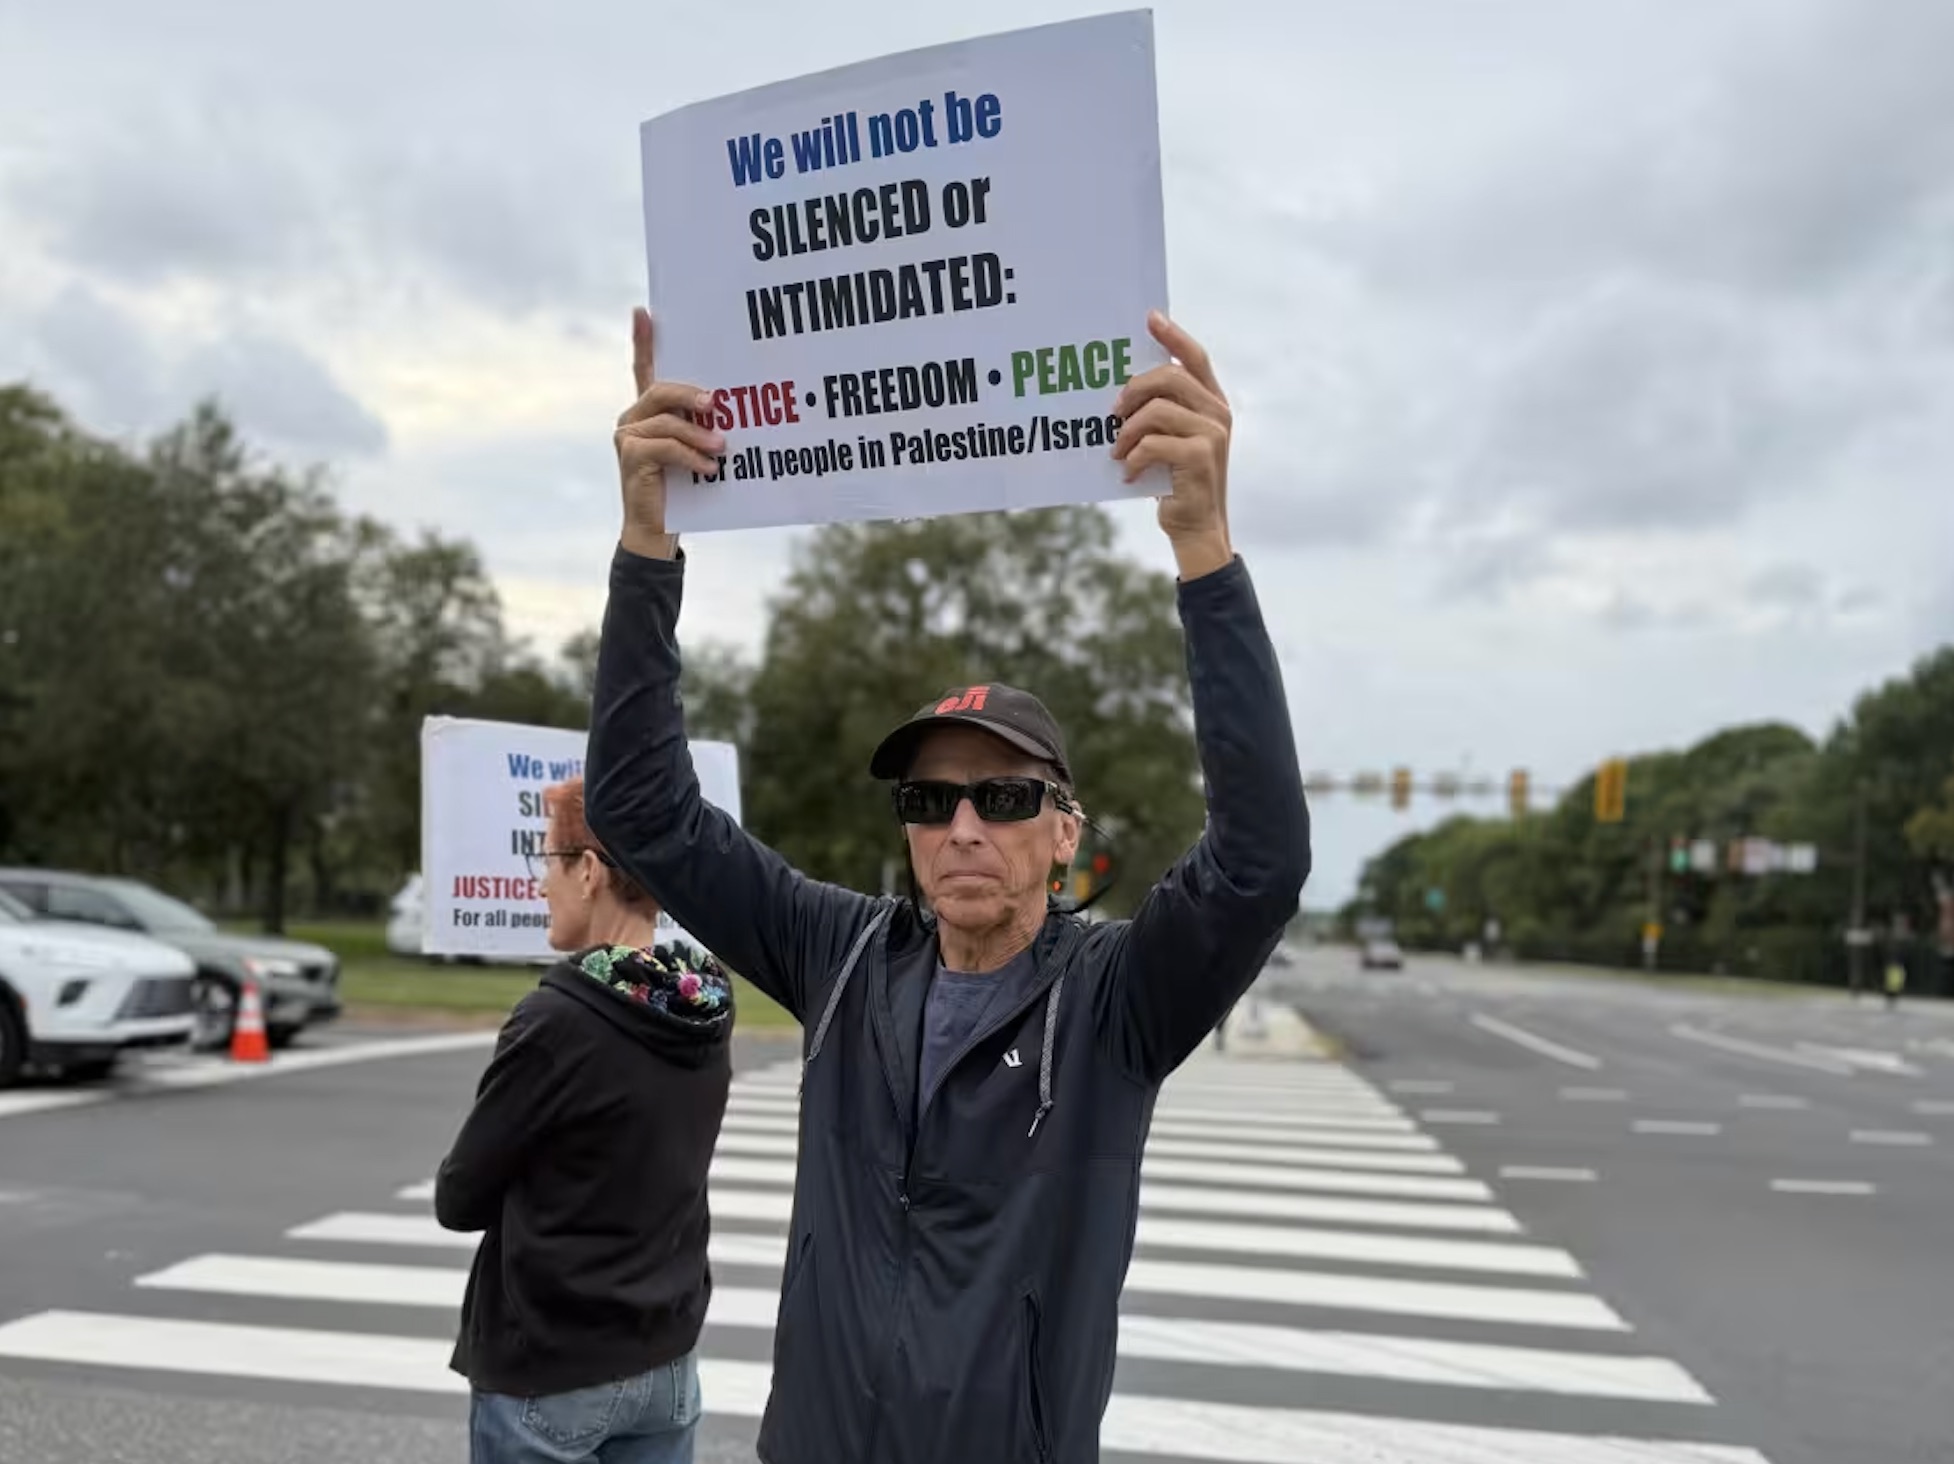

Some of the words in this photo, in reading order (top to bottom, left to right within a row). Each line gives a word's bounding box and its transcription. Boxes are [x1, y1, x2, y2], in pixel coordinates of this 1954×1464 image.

[727, 133, 785, 187] We
[791, 111, 861, 174] will
[868, 99, 938, 158] not
[944, 90, 1001, 144] be
[749, 178, 931, 262] SILENCED
[942, 176, 991, 228] or
[746, 252, 1016, 341] INTIMIDATED:
[823, 357, 979, 419] FREEDOM
[1011, 337, 1133, 398] PEACE
[733, 445, 764, 481] all
[768, 438, 854, 482] people
[858, 435, 885, 470] in
[889, 413, 1127, 466] Palestine/Israe
[507, 753, 544, 781] We
[453, 875, 538, 900] JUSTICE
[454, 908, 480, 928] For
[485, 908, 507, 928] all
